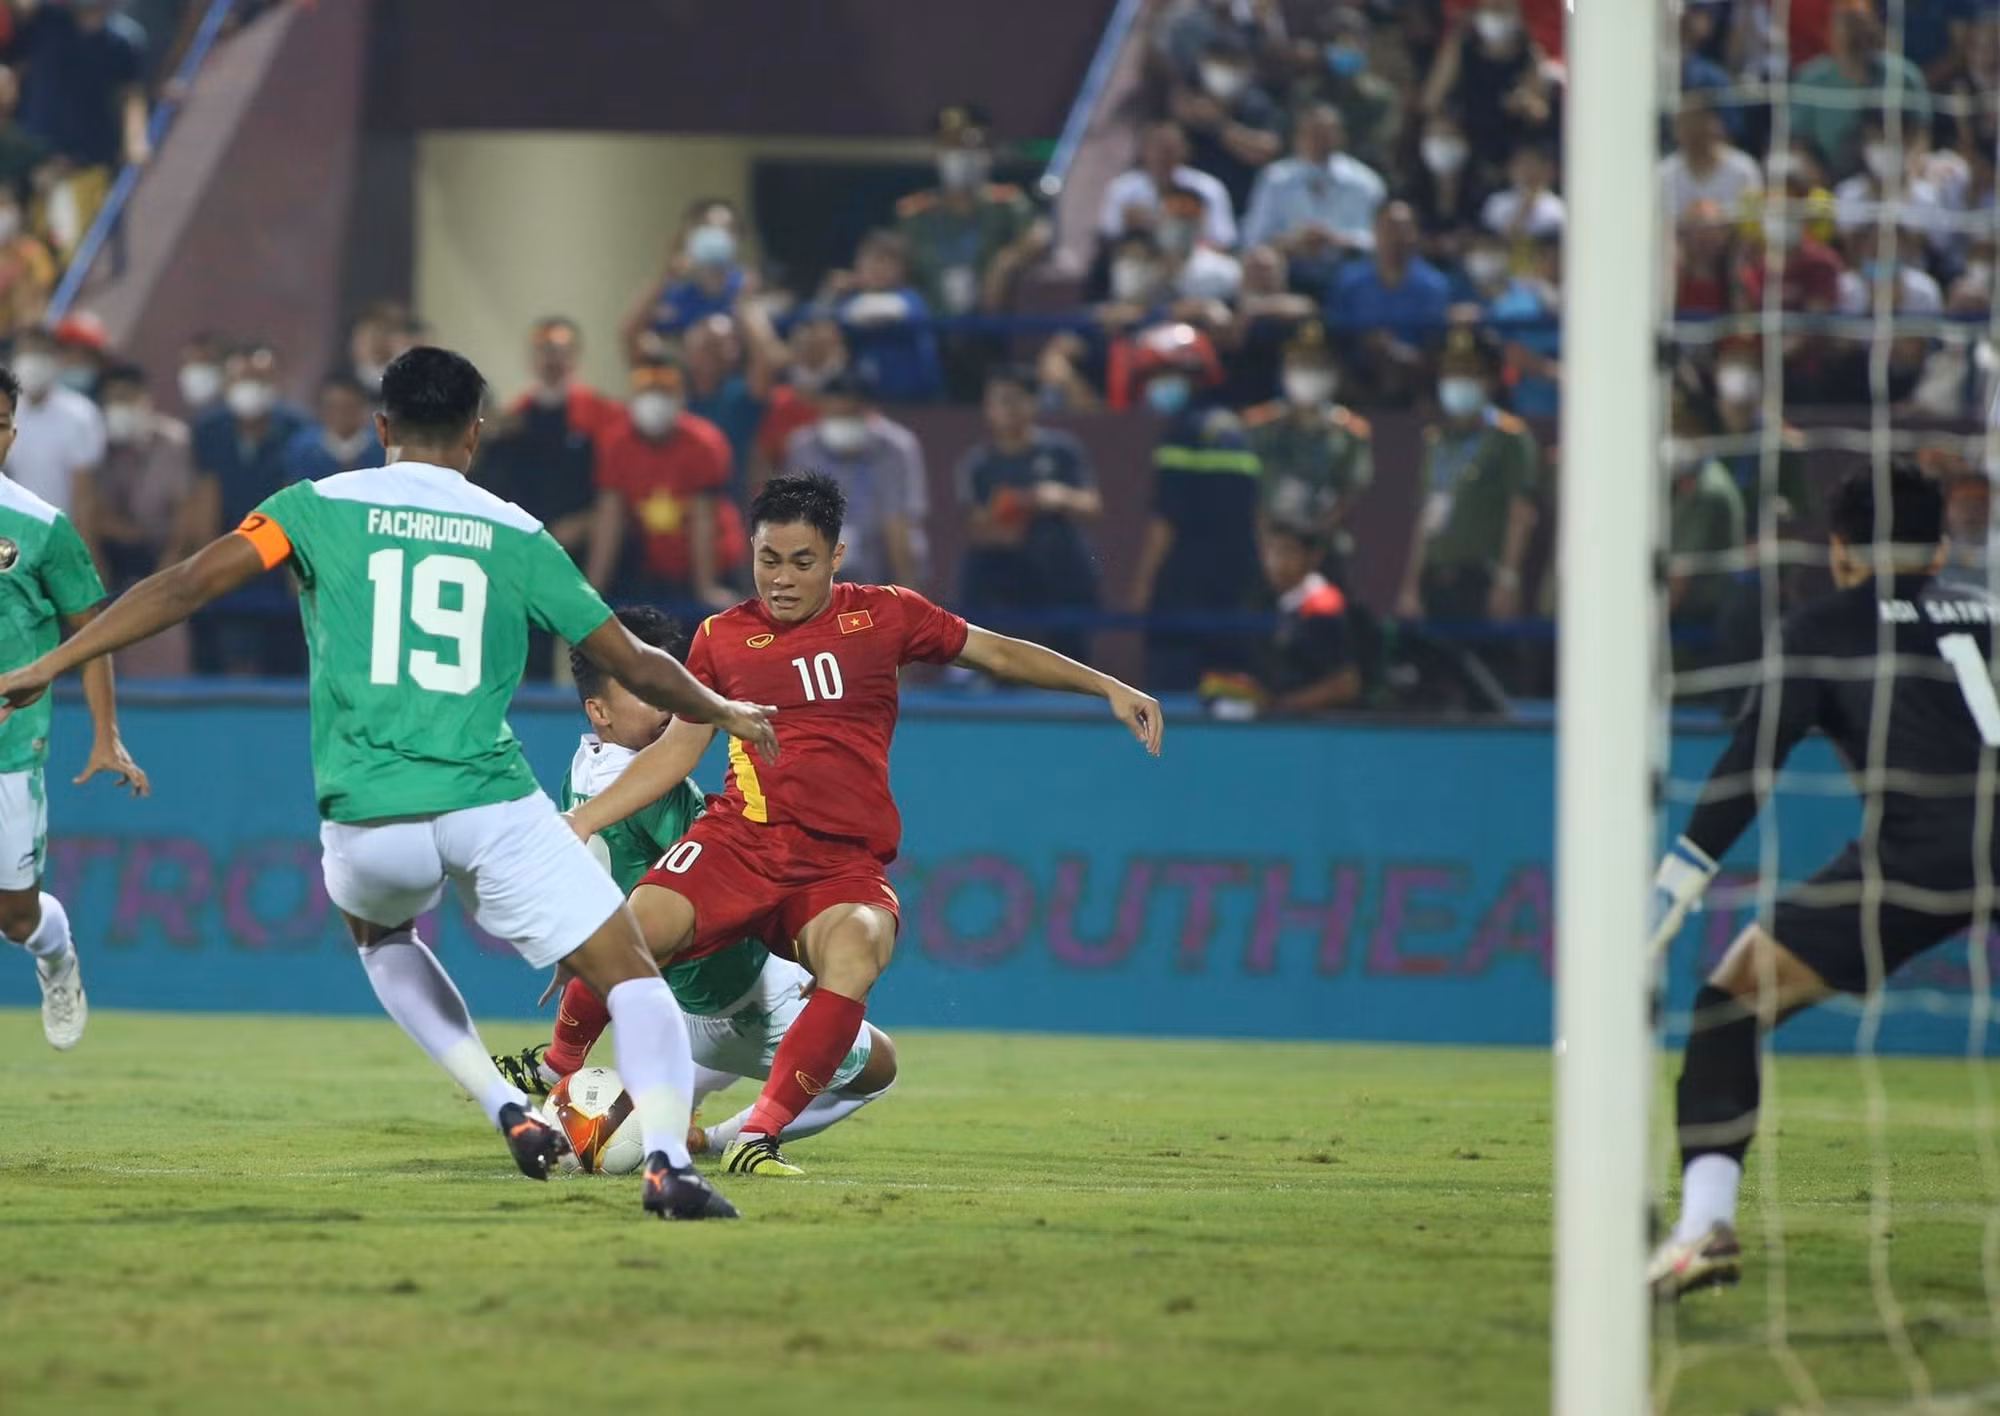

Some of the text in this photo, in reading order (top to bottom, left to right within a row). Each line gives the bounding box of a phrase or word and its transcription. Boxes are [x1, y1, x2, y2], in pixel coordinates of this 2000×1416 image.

[367, 508, 493, 551] FACHRUDDIN
[367, 547, 489, 696] 19
[791, 651, 844, 701] 10
[1936, 632, 2000, 748] 1
[46, 838, 520, 954] TRO
[653, 840, 703, 874] 10
